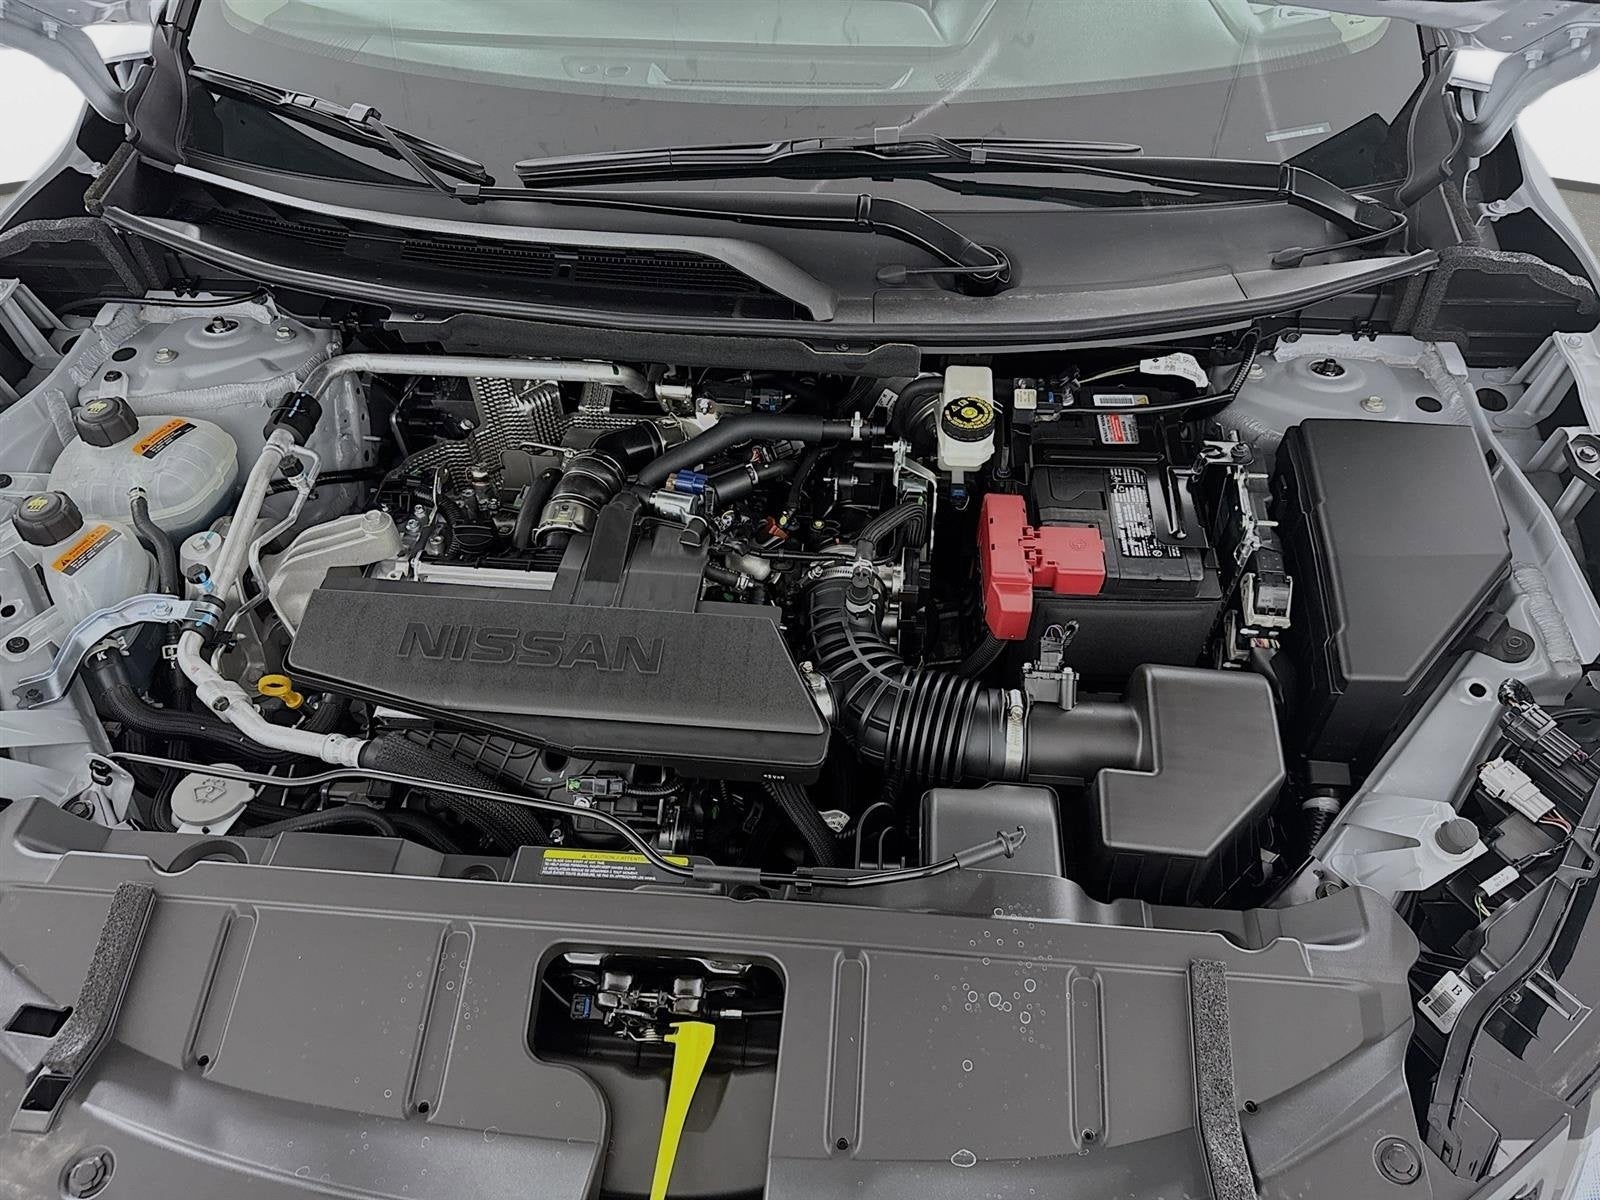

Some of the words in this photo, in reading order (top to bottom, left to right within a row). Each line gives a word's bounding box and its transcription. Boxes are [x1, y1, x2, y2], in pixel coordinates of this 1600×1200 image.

[397, 622, 664, 674] NISSAN
[97, 651, 107, 661] K
[1451, 984, 1463, 996] B
